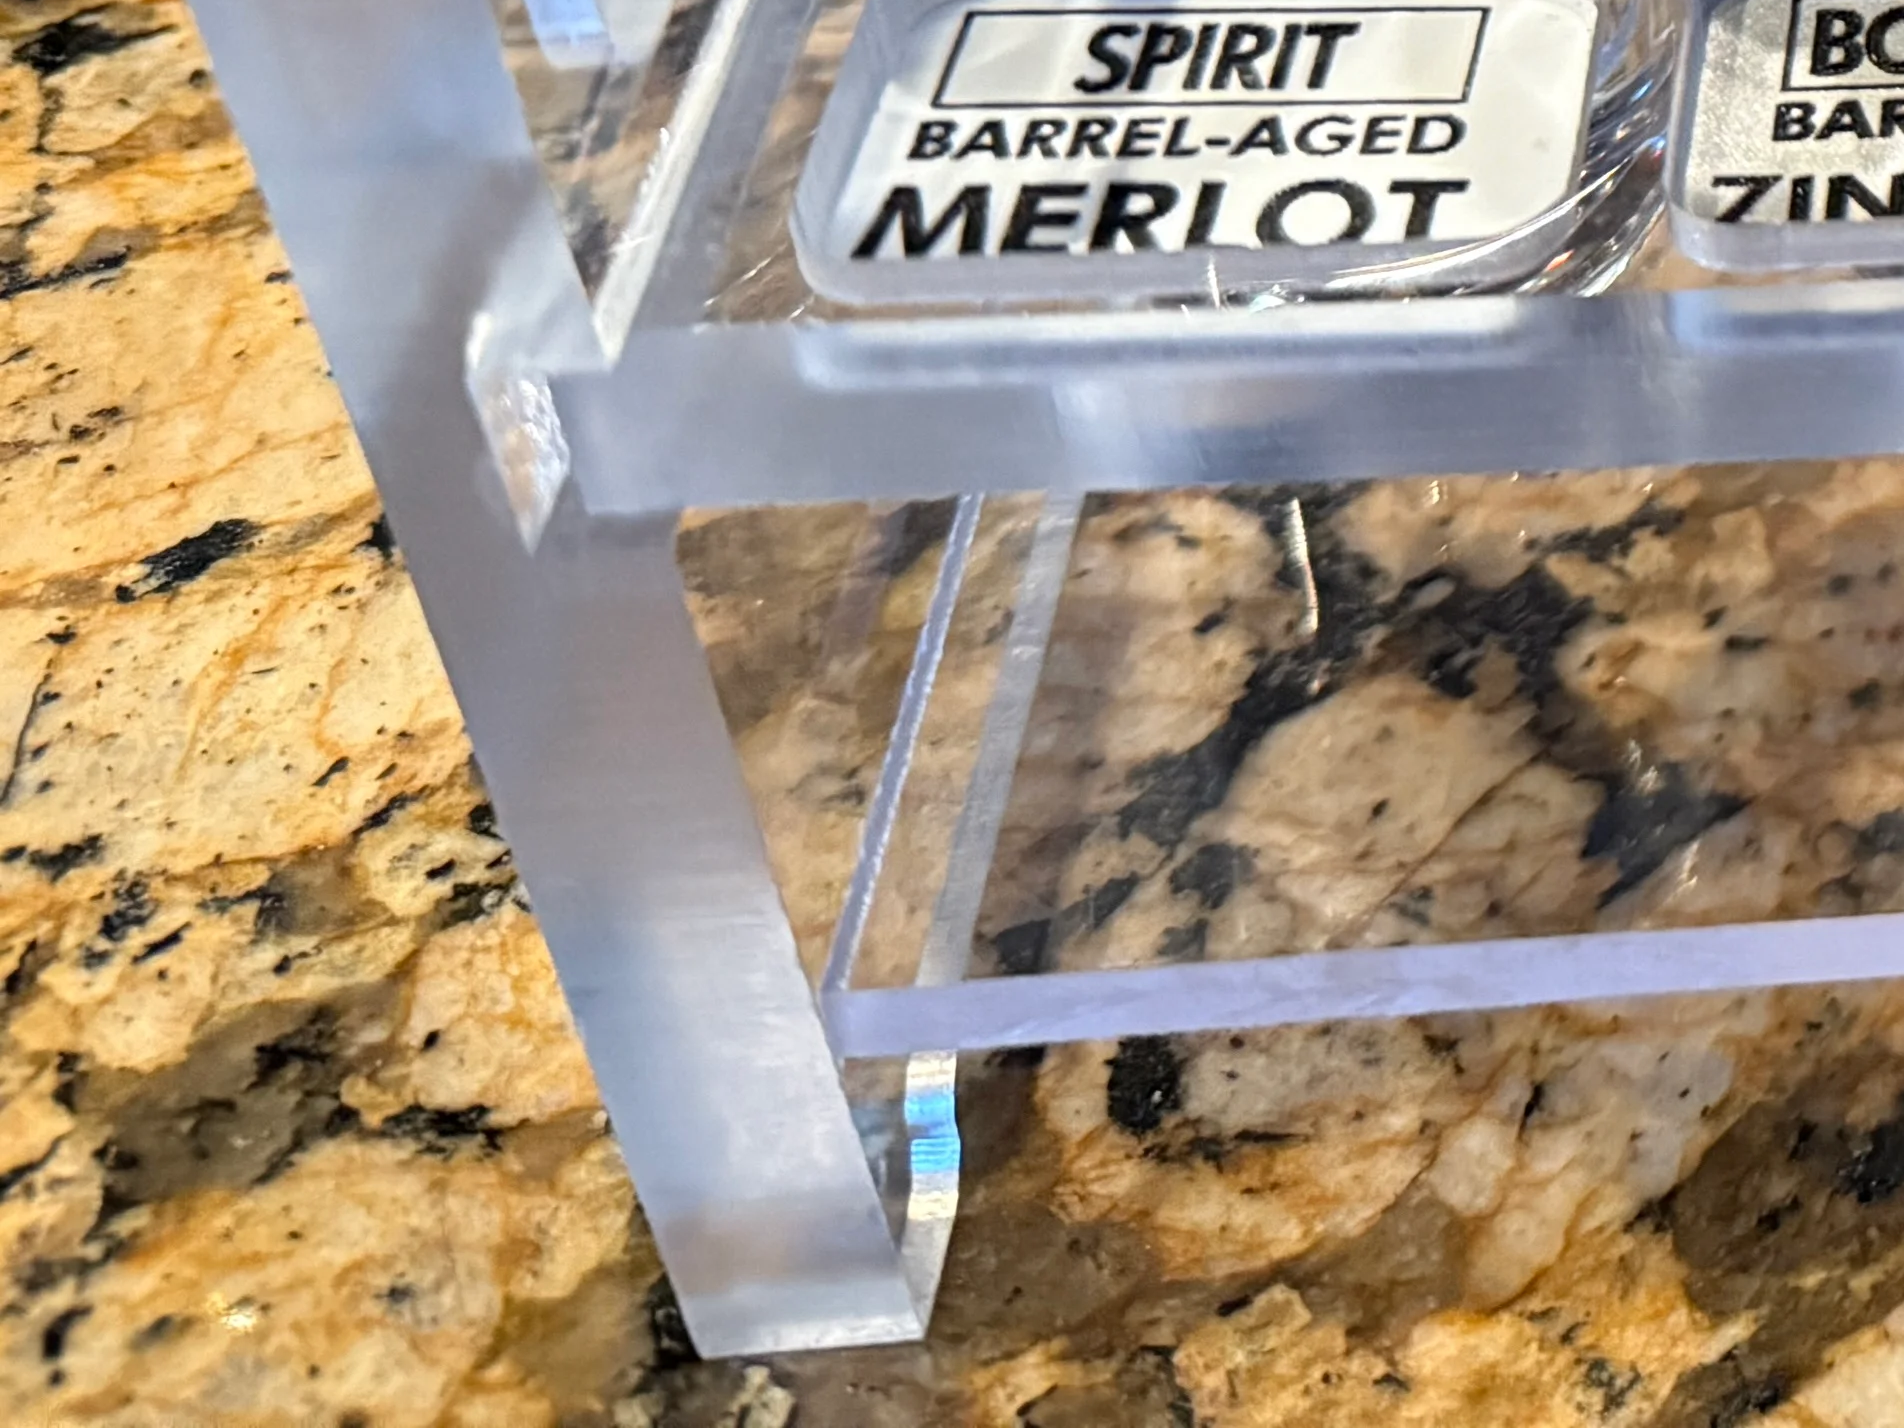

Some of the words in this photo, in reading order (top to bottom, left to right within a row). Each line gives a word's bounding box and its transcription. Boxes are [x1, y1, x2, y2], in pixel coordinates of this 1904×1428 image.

[1073, 21, 1362, 95] SPIRIT
[907, 112, 1467, 162] BARREL-AGED
[850, 178, 1471, 261] MERLOT
